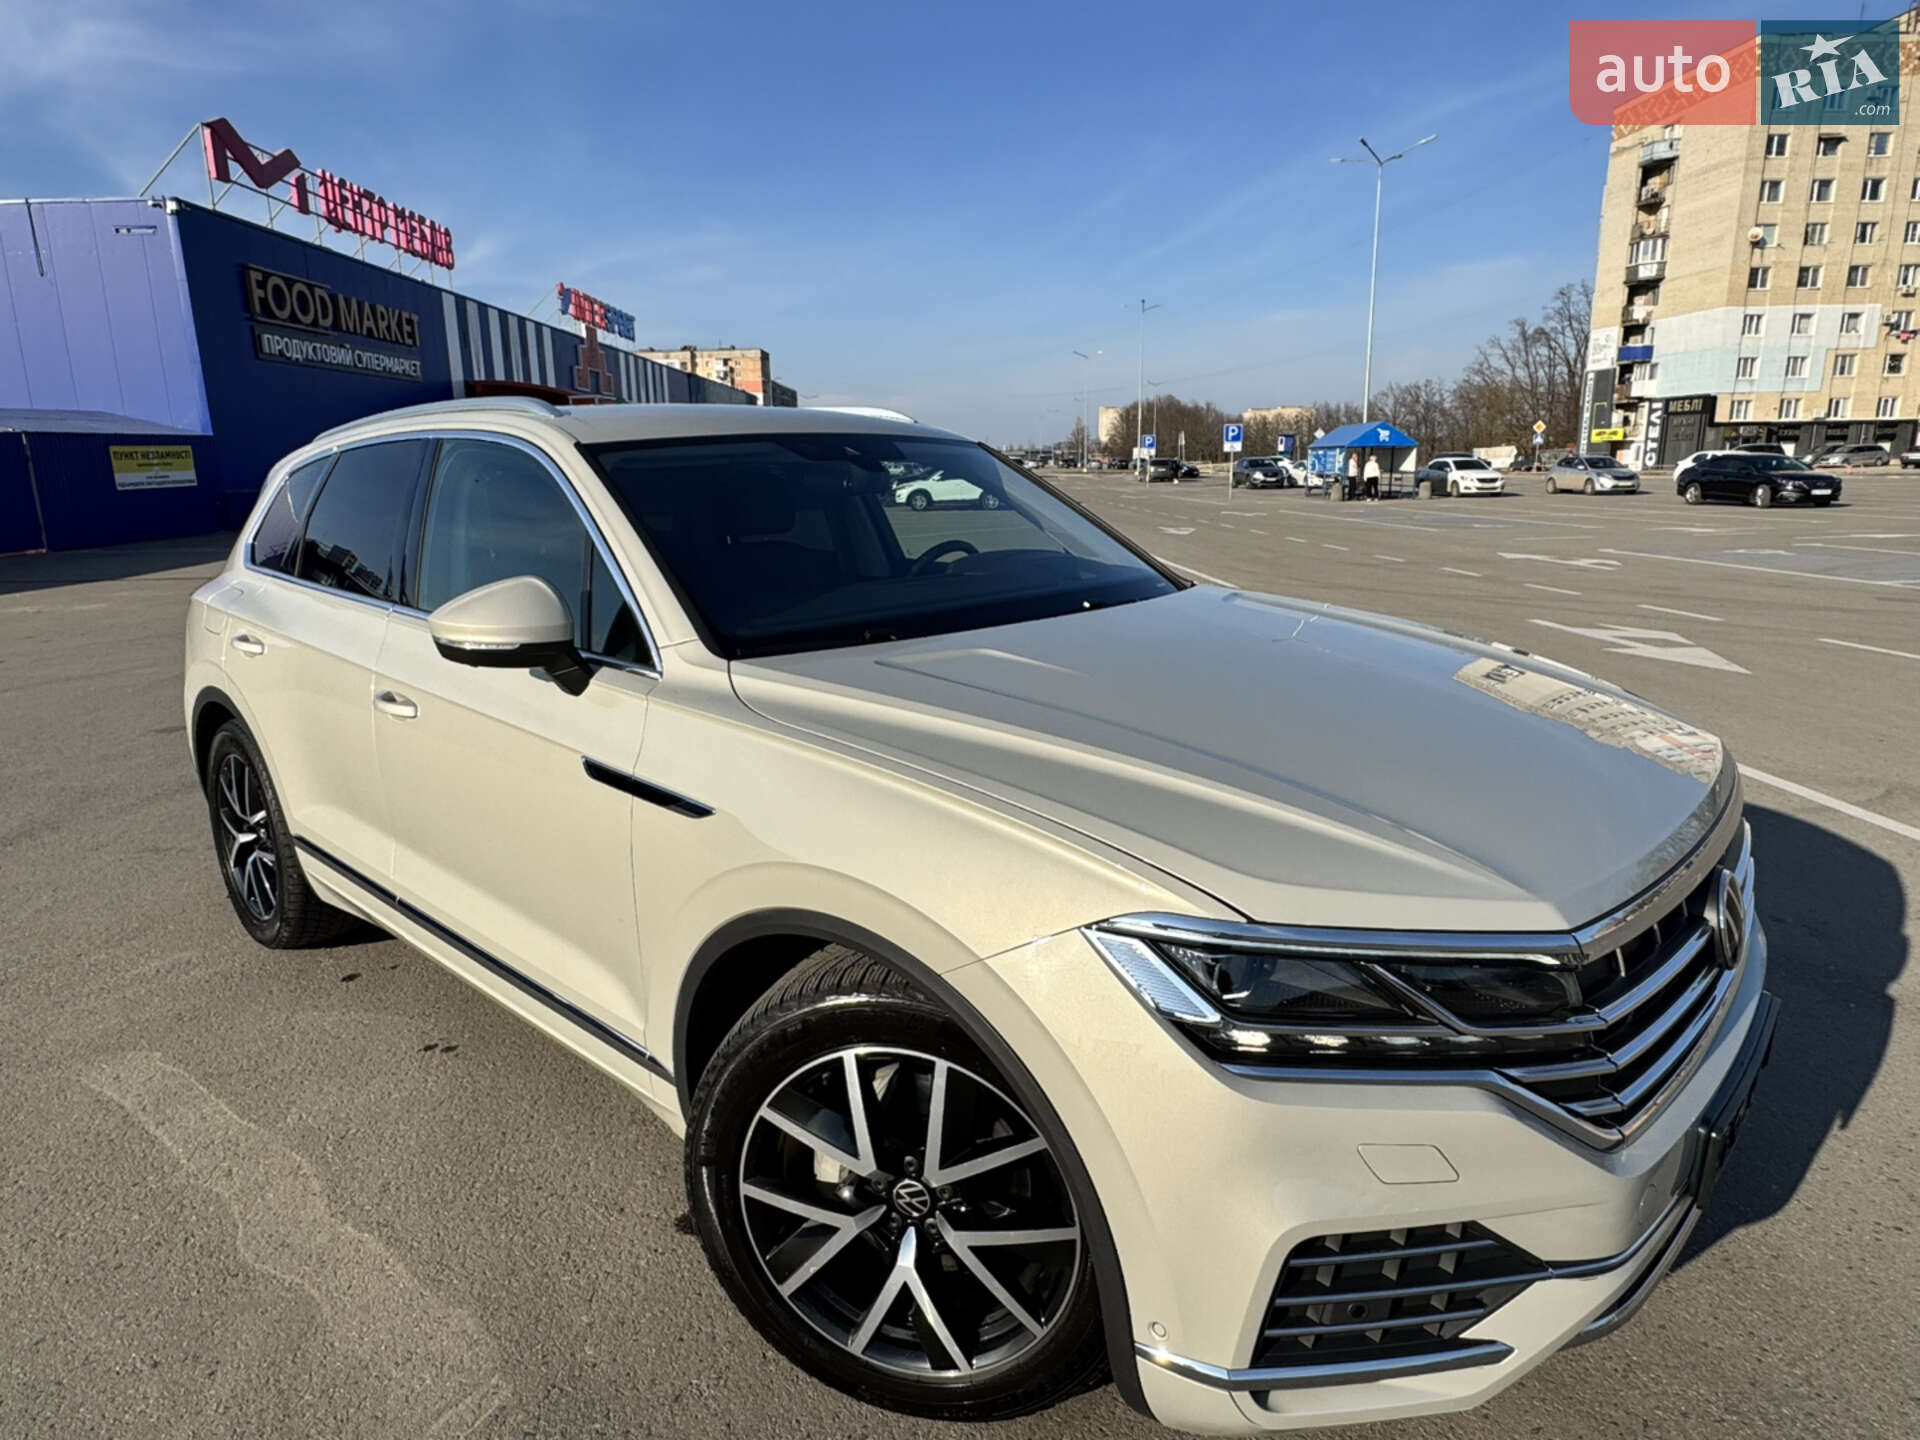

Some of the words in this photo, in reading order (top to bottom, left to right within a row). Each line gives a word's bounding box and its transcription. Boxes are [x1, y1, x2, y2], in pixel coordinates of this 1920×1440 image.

[249, 269, 333, 329] FOOD
[338, 293, 421, 347] MARKET
[261, 333, 353, 367] ПРОДУКТОВИЙ
[354, 350, 422, 377] СУПЕРМАРКЕТ
[1668, 398, 1703, 413] МЕБЛІ
[1644, 401, 1664, 467] СТЕЛІ
